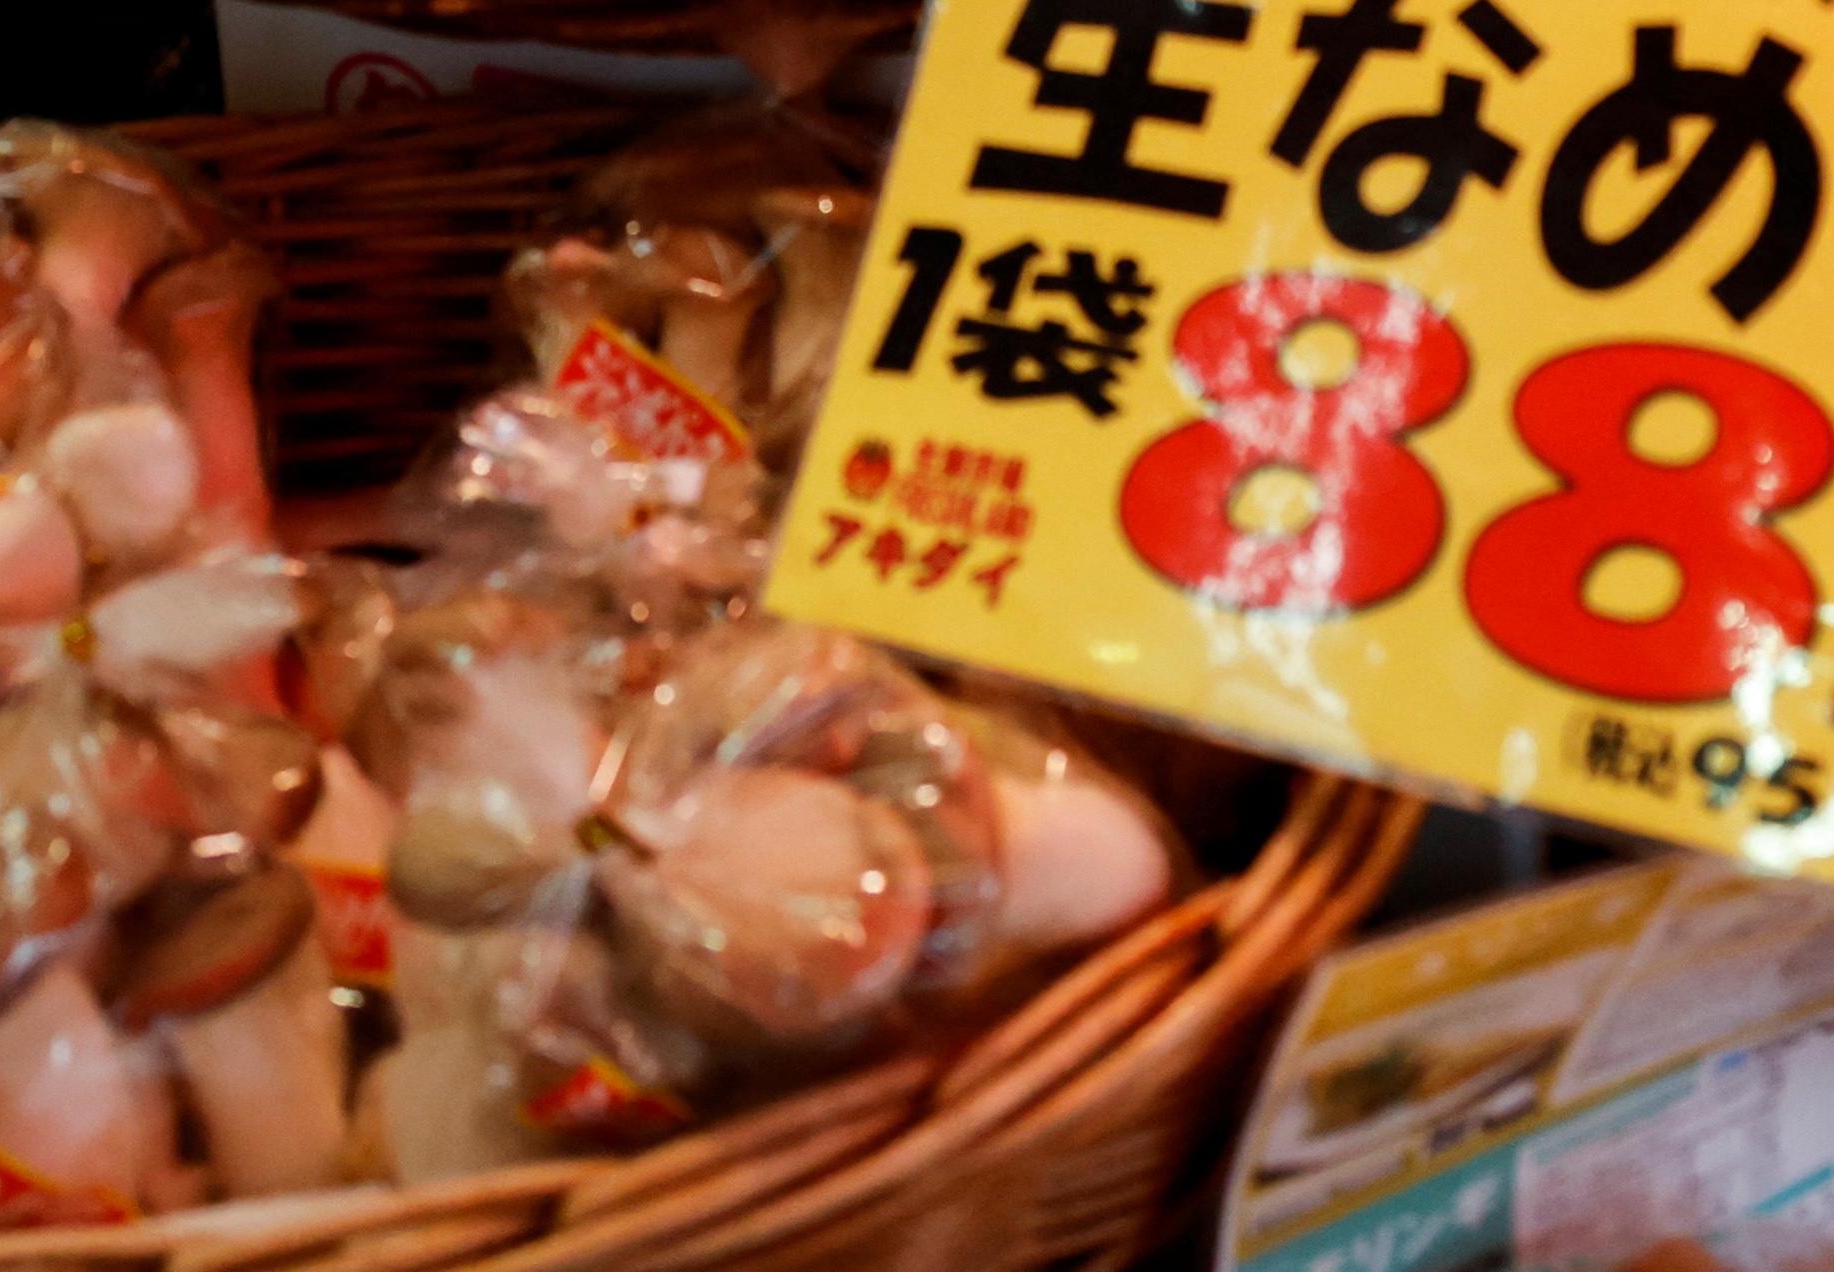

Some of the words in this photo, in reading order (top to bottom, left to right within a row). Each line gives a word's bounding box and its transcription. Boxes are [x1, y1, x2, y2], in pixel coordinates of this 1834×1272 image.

[867, 225, 1157, 422] 1袋
[811, 512, 1024, 611] アキダイ
